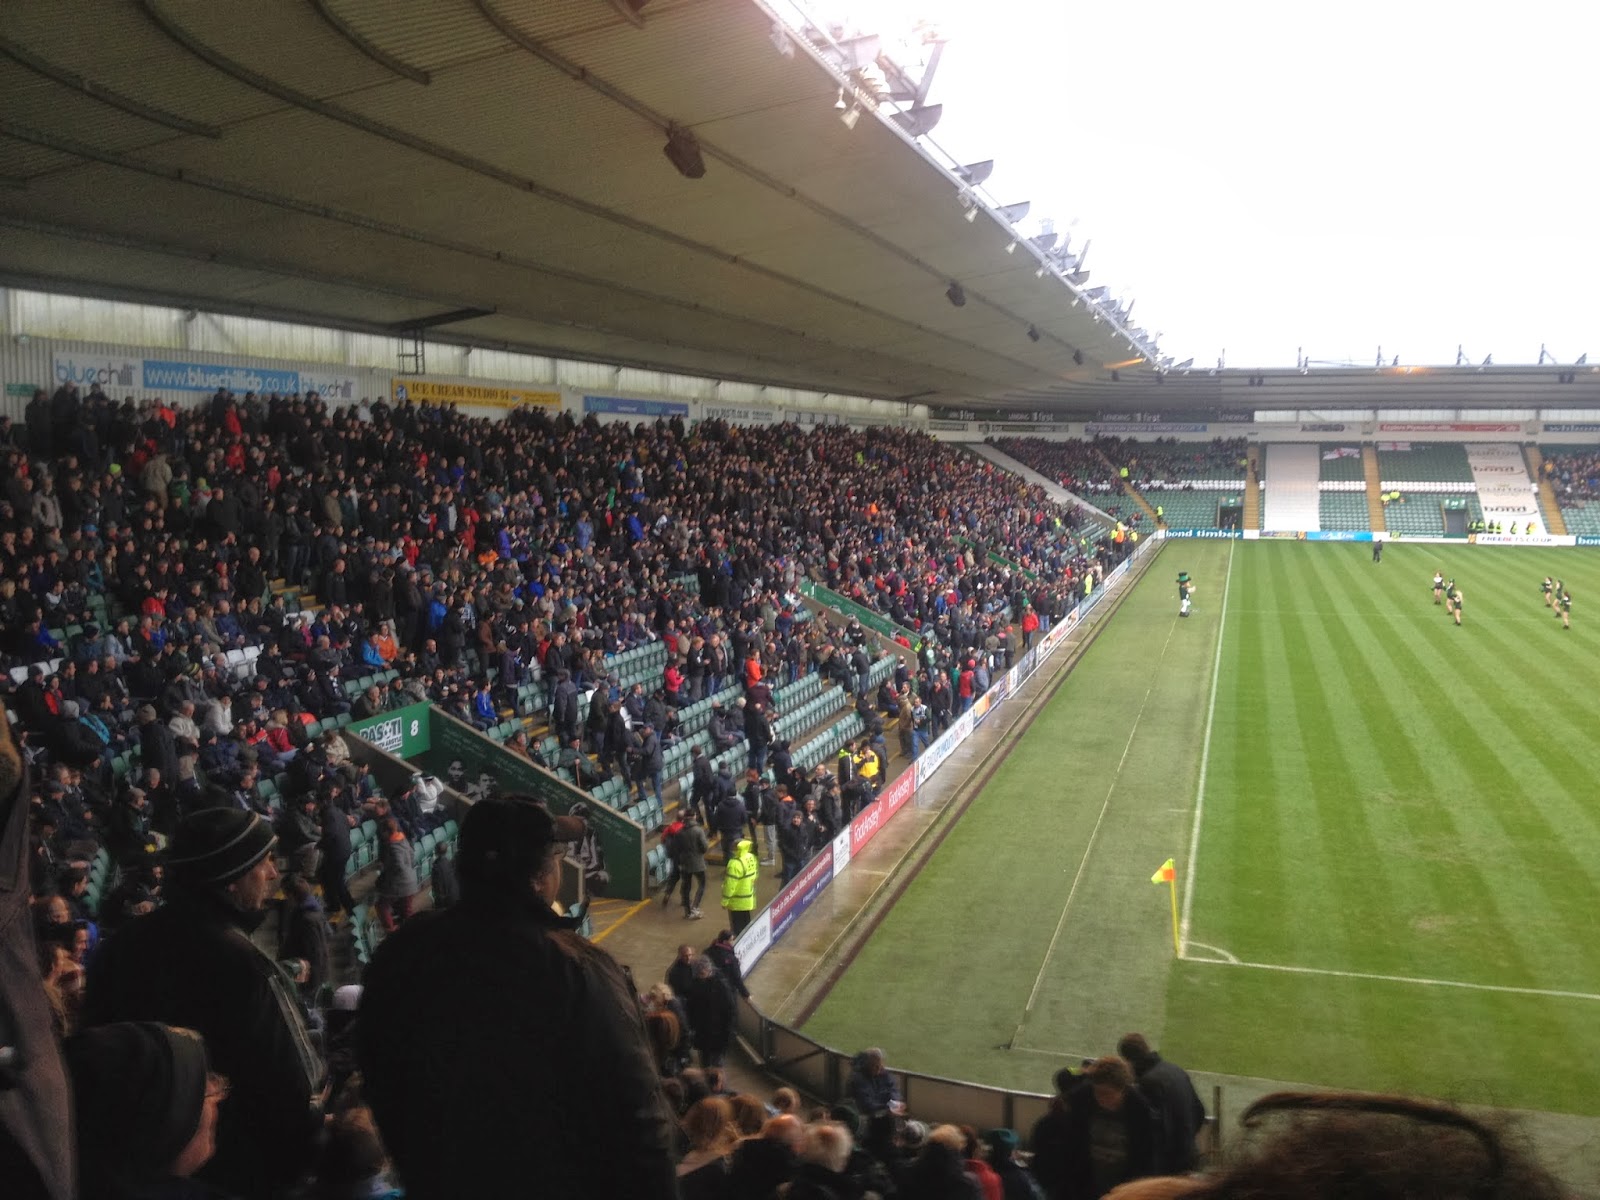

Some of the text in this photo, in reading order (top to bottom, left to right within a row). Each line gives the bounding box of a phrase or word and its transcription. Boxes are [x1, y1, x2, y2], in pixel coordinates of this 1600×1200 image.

[431, 384, 464, 396] CREAM
[467, 387, 497, 398] STUDIO
[1165, 529, 1241, 538] bond timber
[410, 719, 419, 737] 8
